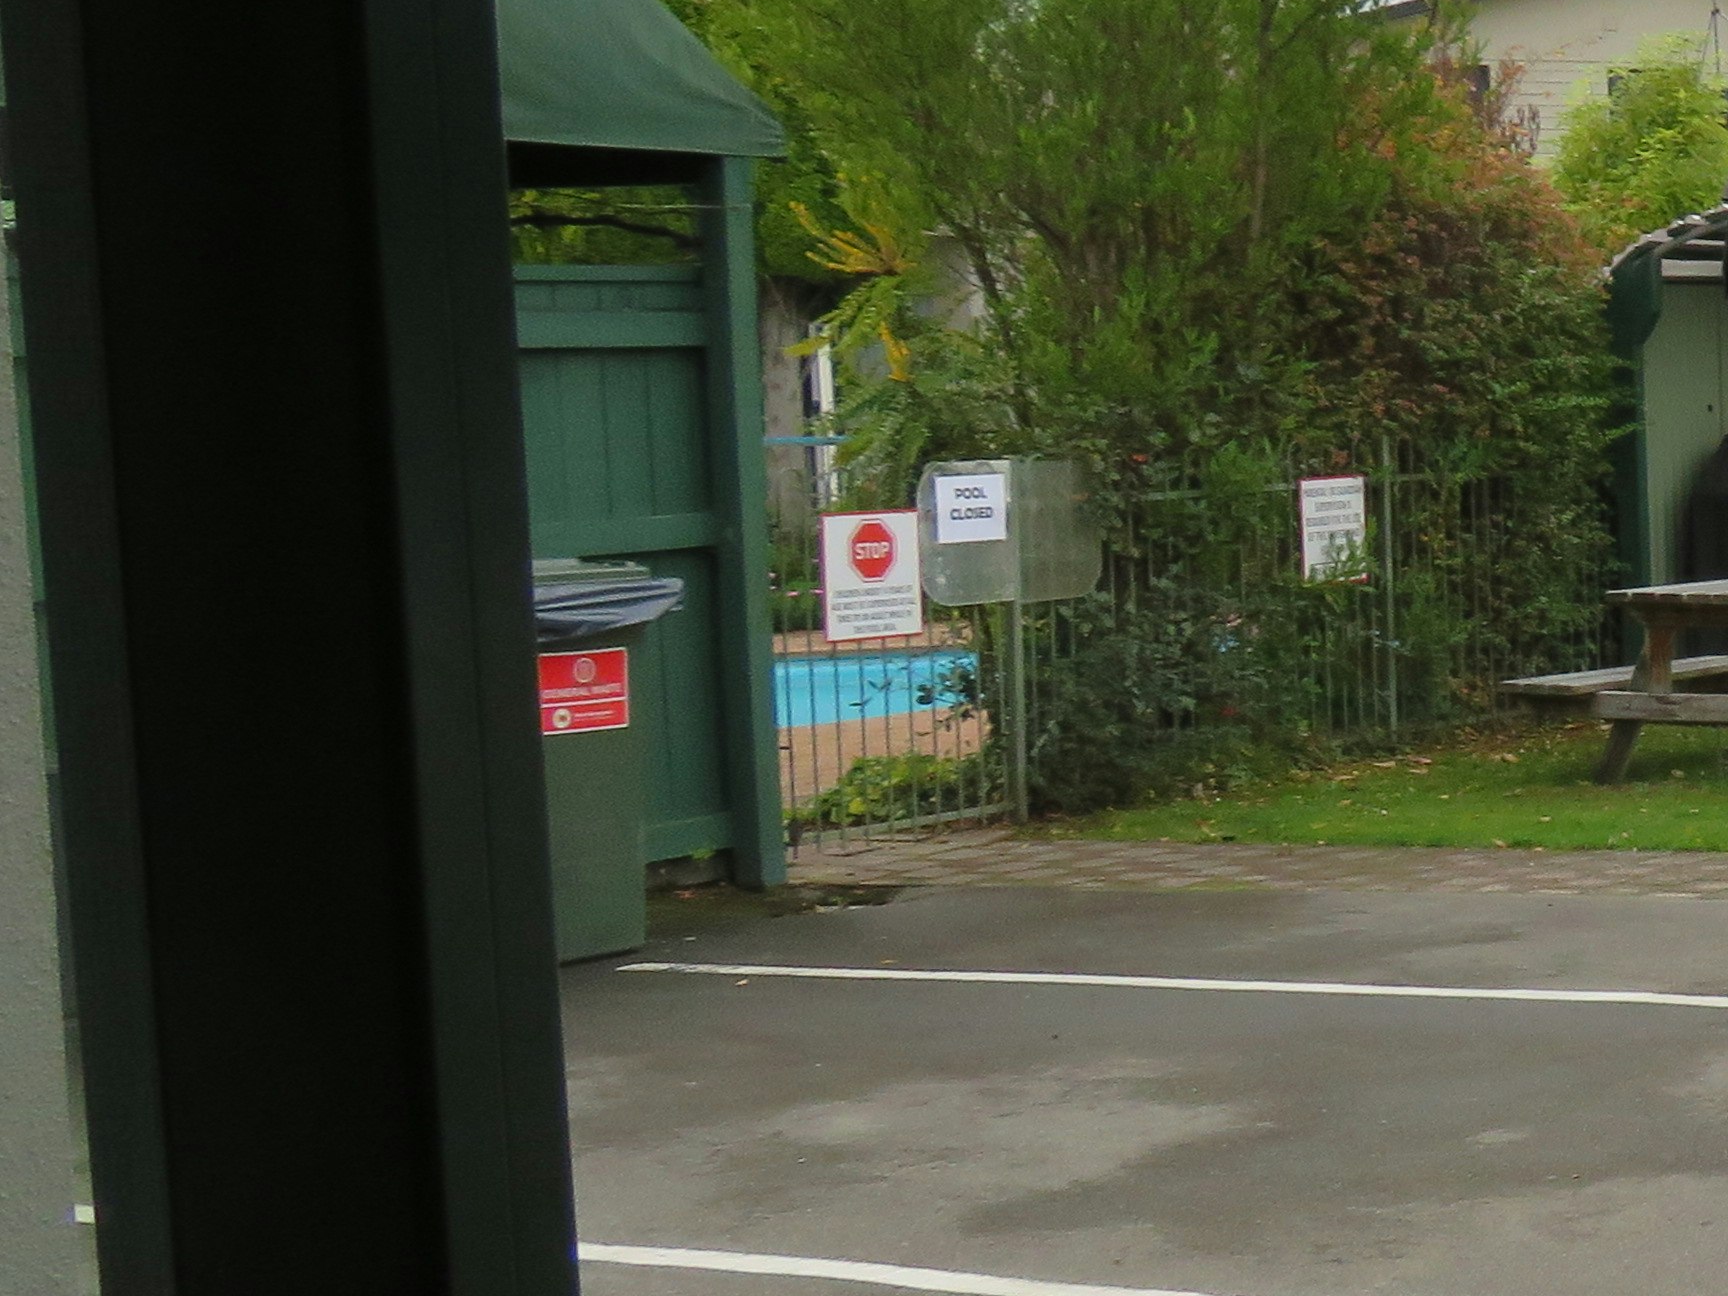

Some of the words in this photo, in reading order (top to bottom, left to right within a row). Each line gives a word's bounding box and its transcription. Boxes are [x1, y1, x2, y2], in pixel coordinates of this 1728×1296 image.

[954, 487, 988, 499] POOL
[950, 506, 993, 520] CLOSED
[855, 541, 889, 559] STOP
